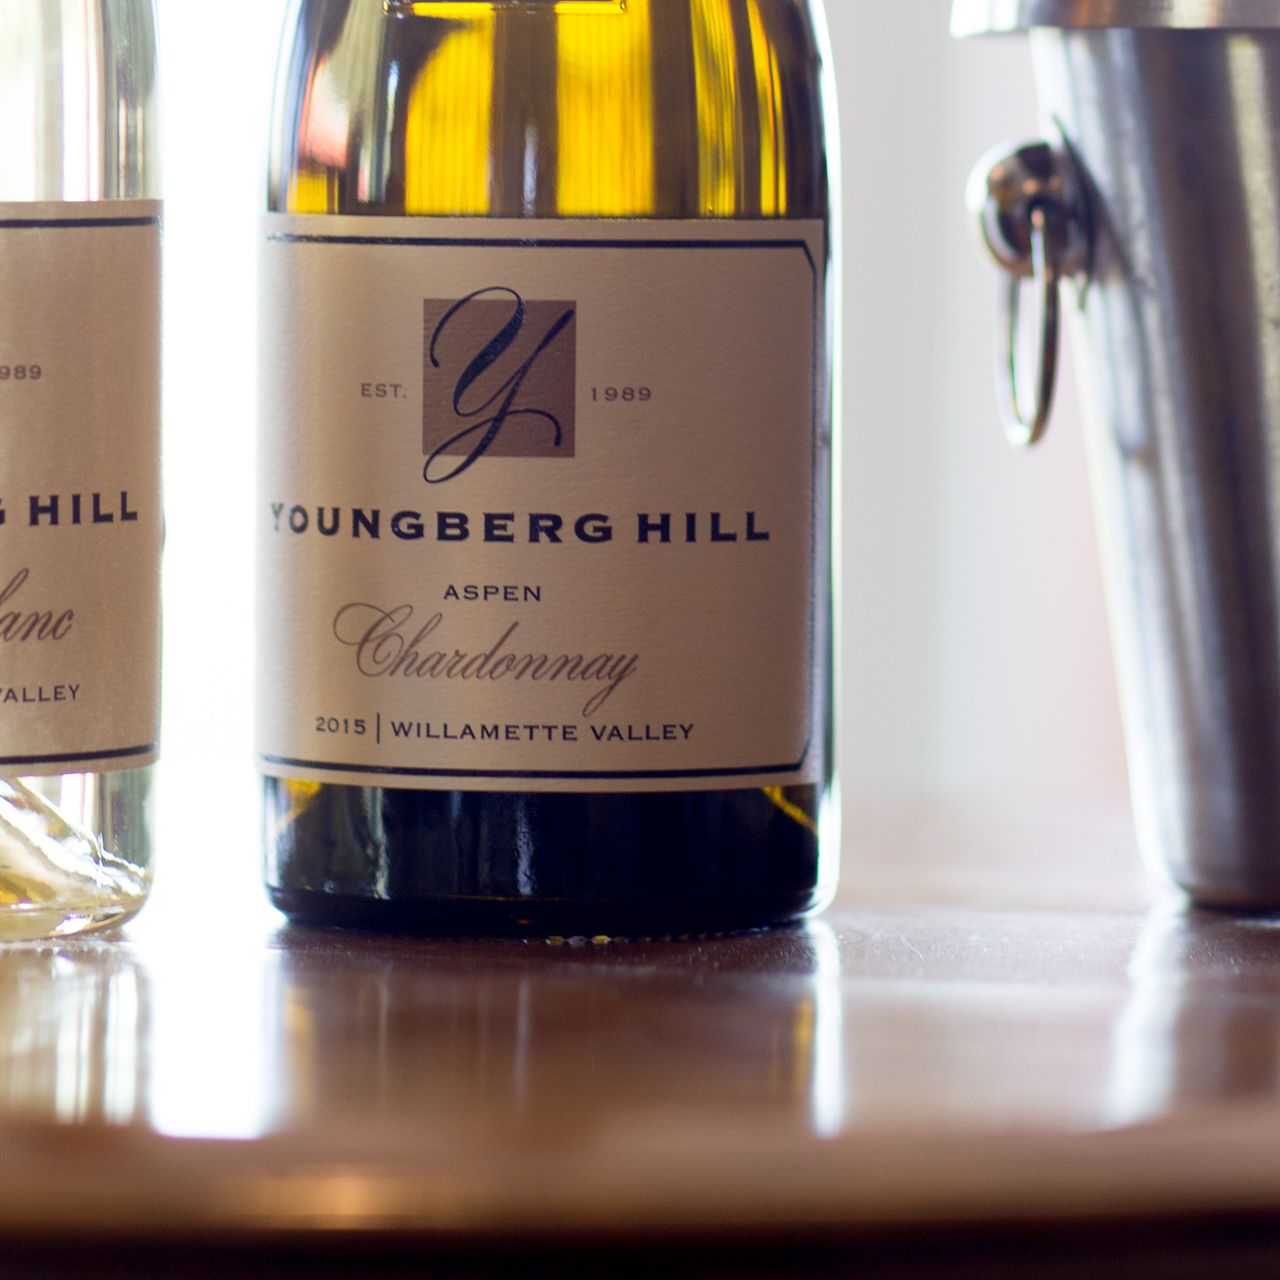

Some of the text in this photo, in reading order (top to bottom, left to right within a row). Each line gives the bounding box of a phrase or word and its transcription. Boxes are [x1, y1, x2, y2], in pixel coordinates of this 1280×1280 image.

[360, 382, 653, 402] EST. 1989
[423, 285, 576, 484] Y
[27, 490, 139, 528] HILL
[270, 501, 771, 544] YOUNGBERG HILL
[442, 583, 543, 603] ASPEN
[332, 601, 639, 717] Chardonnay
[314, 716, 695, 742] 2015 WILLAMETTE VALLEY
